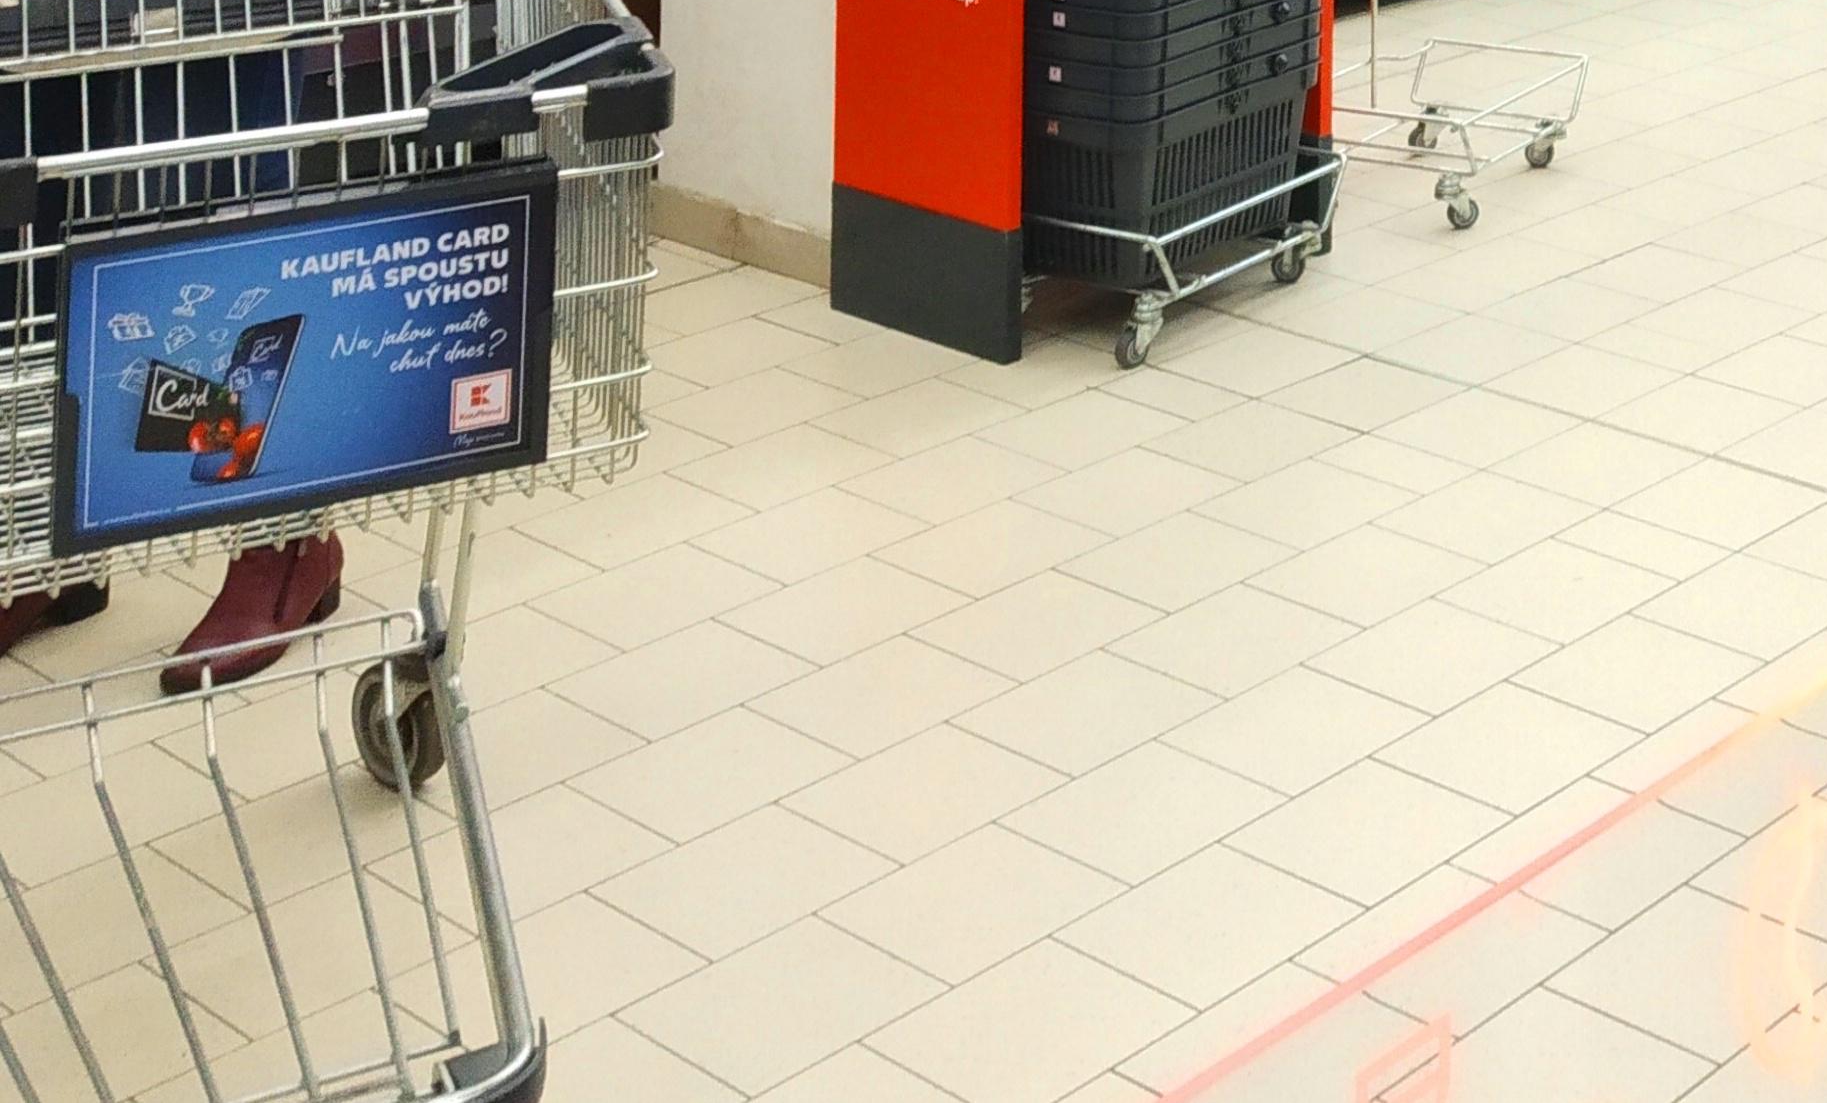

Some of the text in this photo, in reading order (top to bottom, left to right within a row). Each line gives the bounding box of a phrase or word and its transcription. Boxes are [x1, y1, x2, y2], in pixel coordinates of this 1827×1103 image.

[281, 223, 510, 280] KAUFLAND CARD
[331, 248, 510, 298] MÁ SPOUSTU
[404, 273, 509, 311] VÝHOD!
[330, 307, 492, 360] Na jakou máte
[389, 328, 509, 374] chuť dnes?
[154, 378, 211, 413] Card
